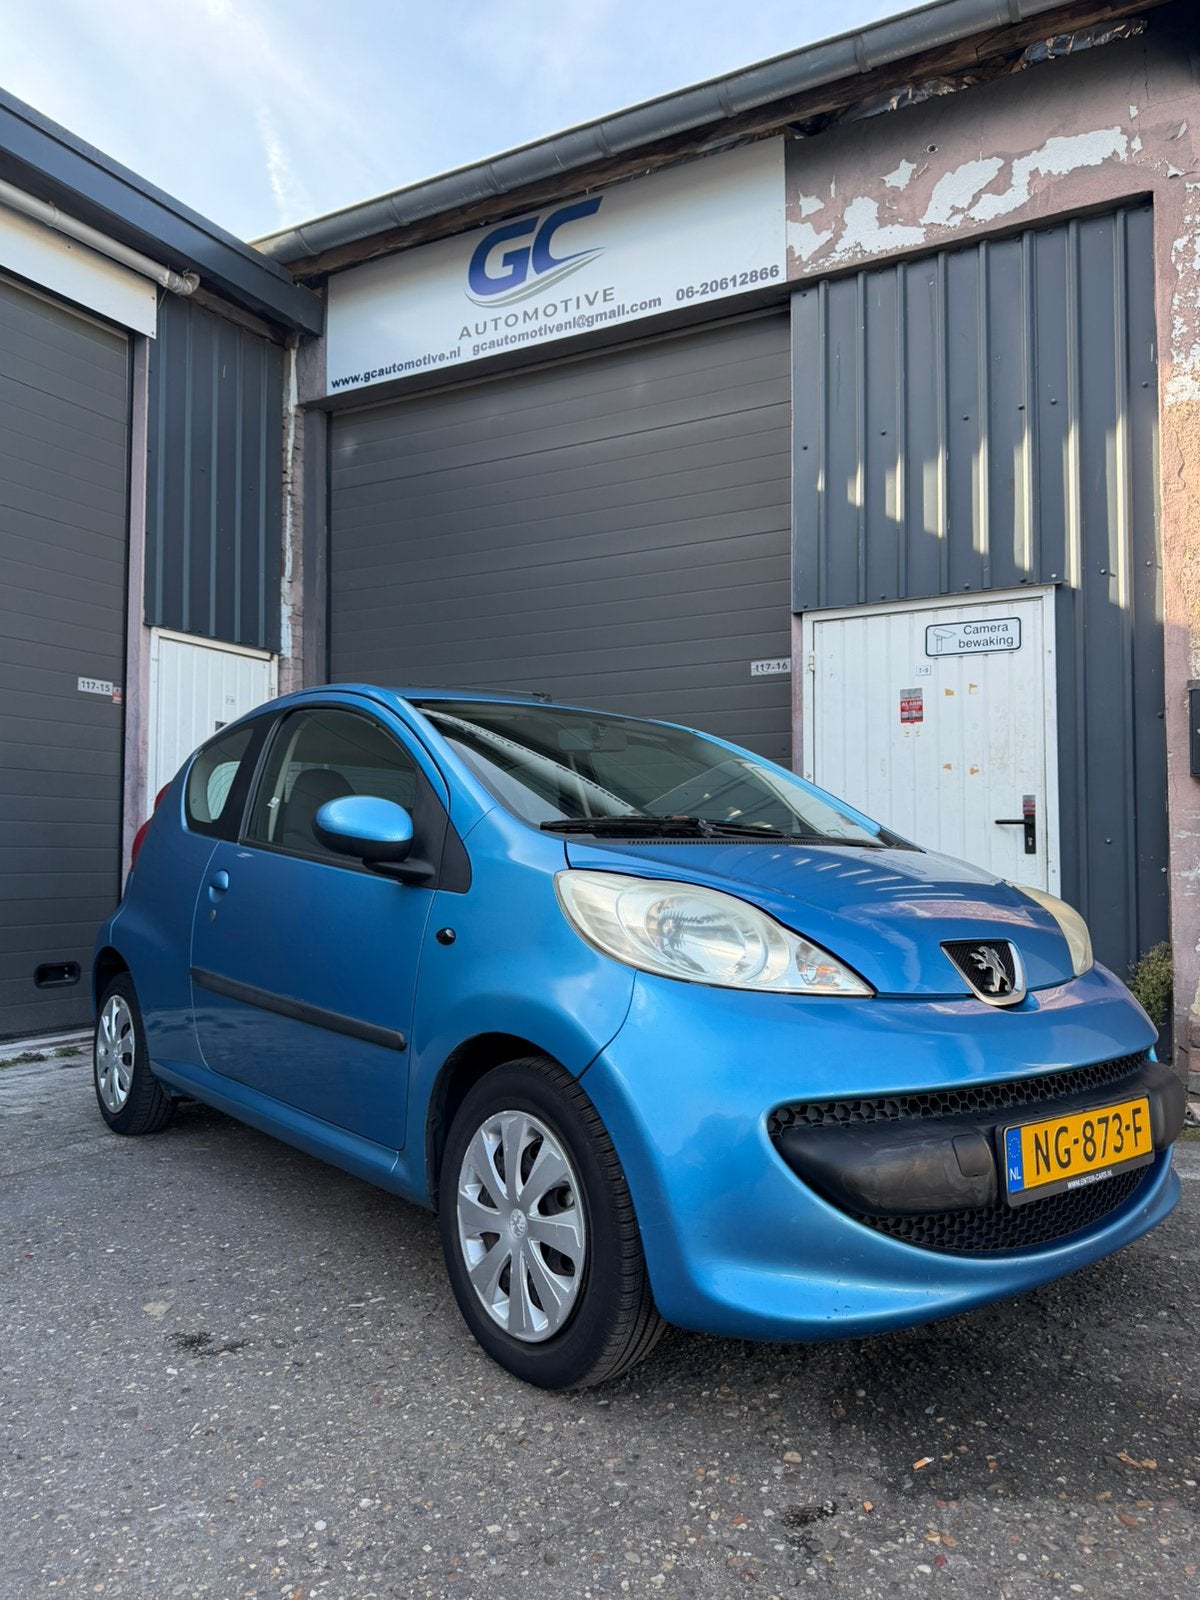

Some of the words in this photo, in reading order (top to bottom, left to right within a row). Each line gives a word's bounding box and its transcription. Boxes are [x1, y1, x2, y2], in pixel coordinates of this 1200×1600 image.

[468, 196, 603, 296] GC
[458, 286, 615, 341] AUTOMOTIVE
[331, 346, 461, 389] www.gcautomotive.nl
[472, 296, 662, 356] gcautomotivenl@gmail.com
[675, 264, 780, 302] 06-20612866
[963, 623, 1009, 635] Camera
[958, 635, 1014, 648] bewaking
[755, 661, 788, 672] 117-16
[81, 680, 111, 692] 117-15
[1034, 1107, 1143, 1176] NG-873-F
[1009, 1168, 1022, 1181] NL
